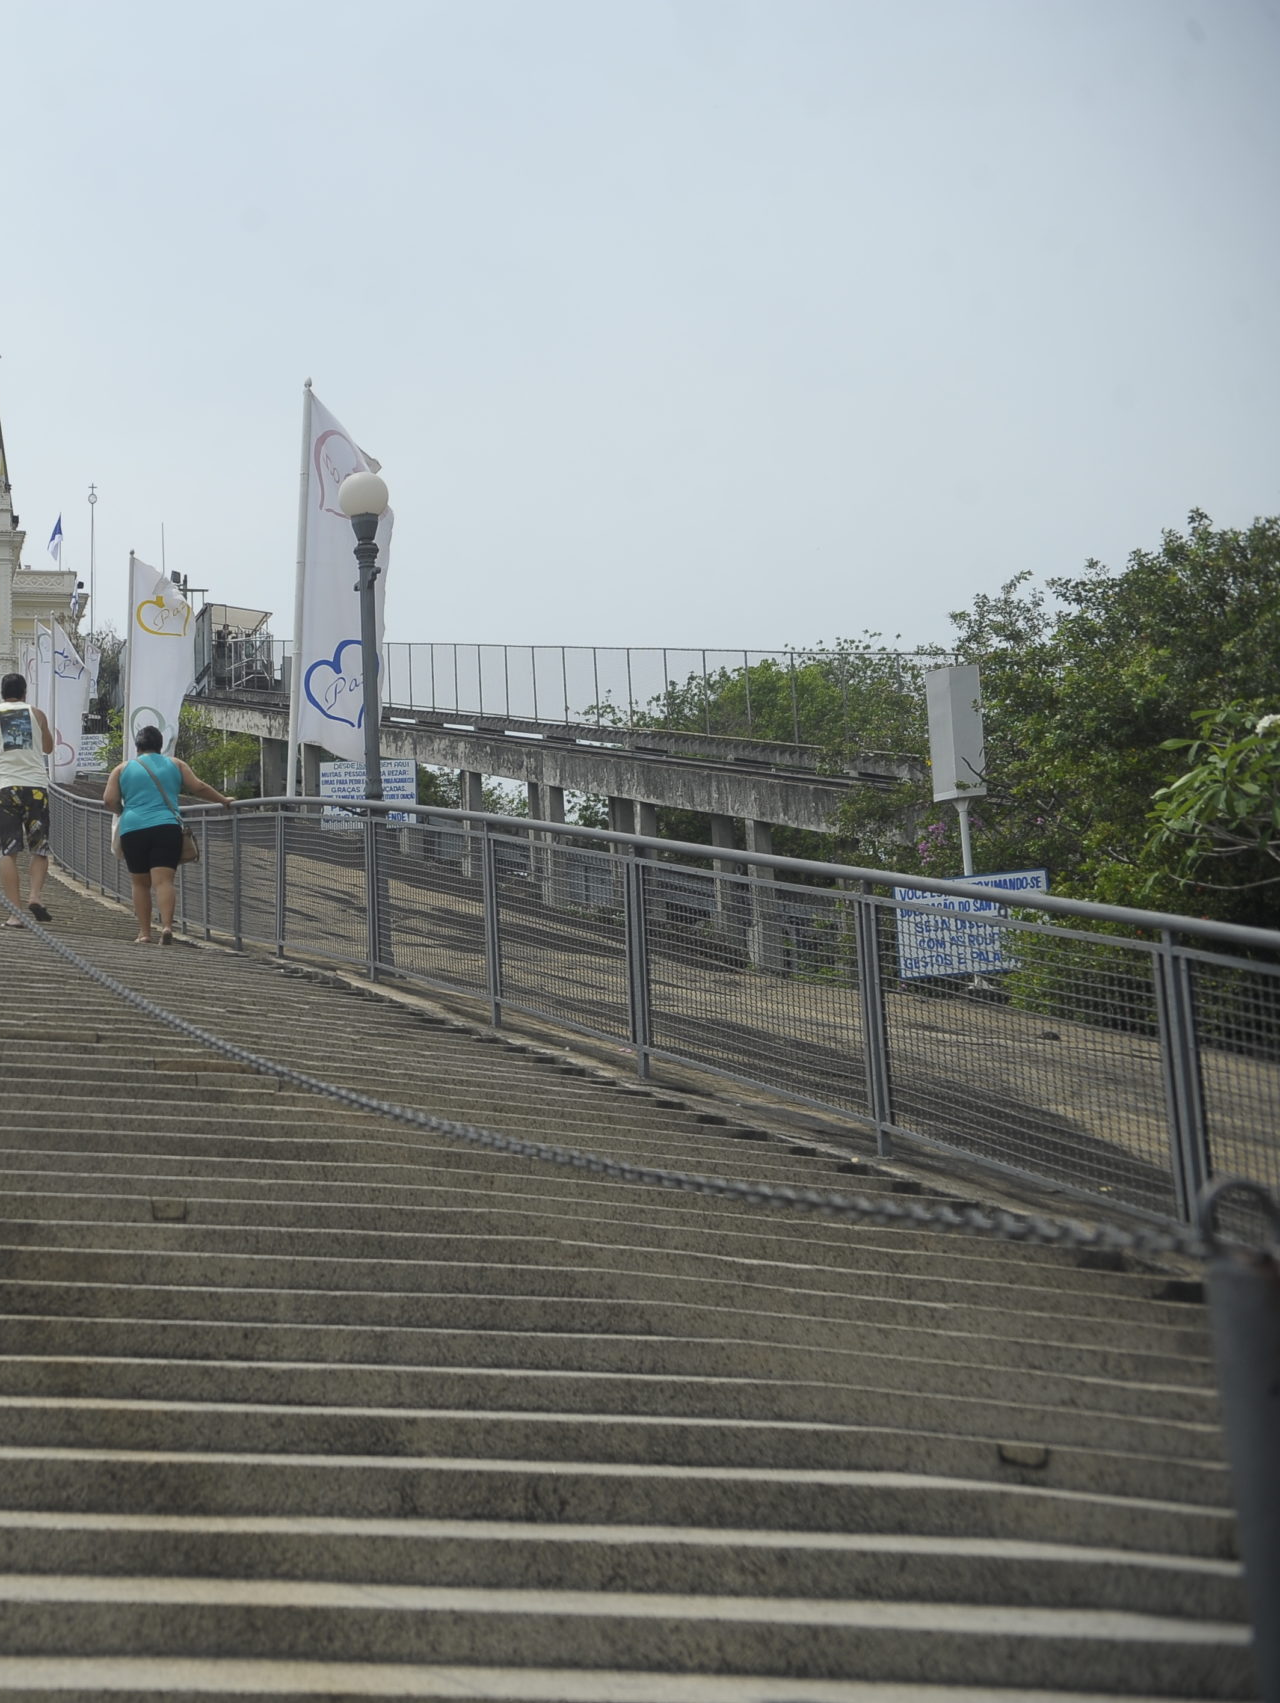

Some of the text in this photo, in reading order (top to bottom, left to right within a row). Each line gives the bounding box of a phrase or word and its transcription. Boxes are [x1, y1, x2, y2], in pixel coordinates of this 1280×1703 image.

[152, 602, 187, 631] Paz
[58, 658, 80, 674] Pa
[334, 762, 355, 770] DESDE
[331, 786, 361, 794] GRAÇAS
[919, 938, 946, 950] COM
[904, 954, 953, 970] GESTOS
[958, 951, 966, 964] E
